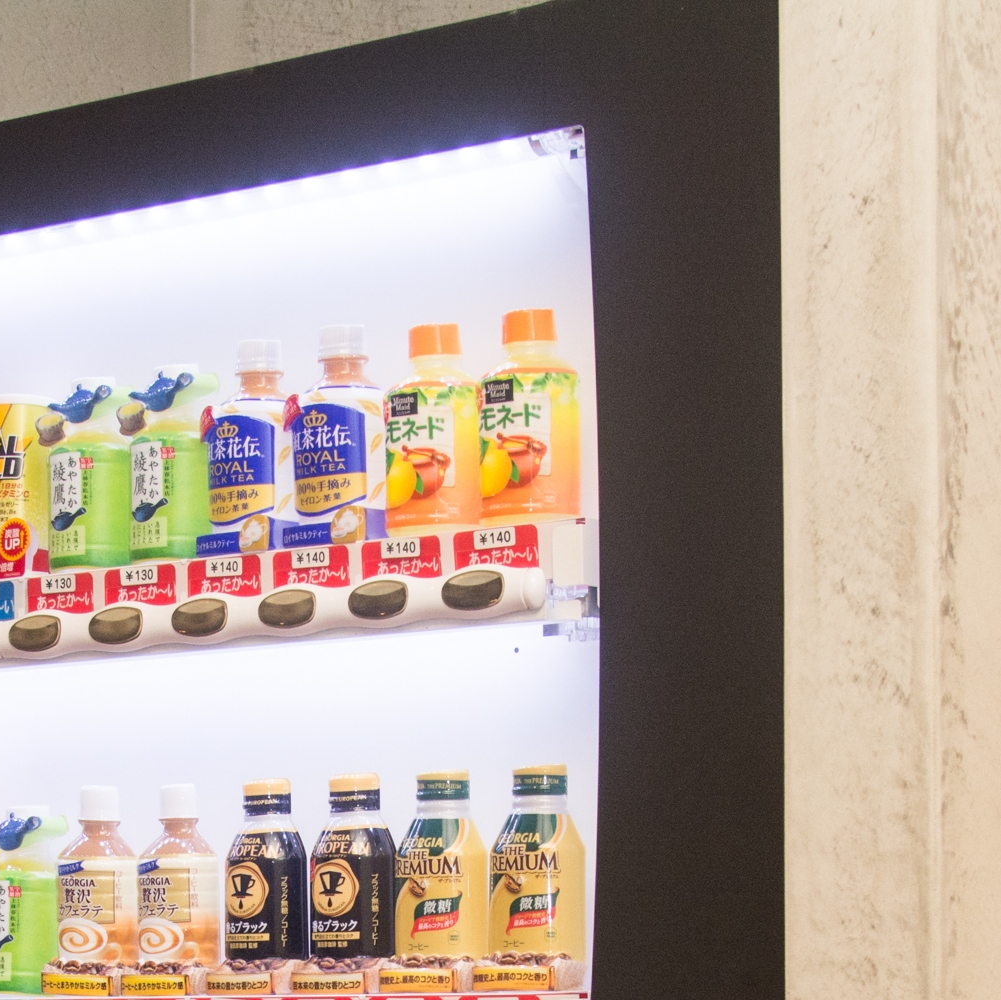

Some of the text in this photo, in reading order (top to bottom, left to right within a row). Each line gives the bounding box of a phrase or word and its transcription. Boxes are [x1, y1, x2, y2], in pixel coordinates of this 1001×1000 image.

[296, 449, 346, 467] ROYAL
[133, 451, 148, 496] 綾鷹
[148, 445, 160, 499] あやたか
[321, 463, 346, 473] TEA
[52, 461, 67, 506] 綾鷹
[66, 455, 79, 509] あやたか
[231, 473, 255, 483] TEA
[4, 537, 20, 550] UP
[479, 531, 511, 545] ¥140
[386, 541, 416, 555] ¥140
[296, 551, 326, 565] ¥140
[211, 561, 239, 573] ¥140
[125, 569, 154, 582] ¥130
[45, 577, 72, 590] ¥130
[407, 850, 428, 861] THE
[503, 846, 525, 857] THE
[397, 856, 463, 877] REMIUM
[492, 851, 561, 872] REMIUM
[61, 875, 98, 888] GEORGIA
[139, 876, 173, 888] GEORGIA
[64, 888, 92, 904] 贅沢
[142, 888, 167, 903] 贅沢
[59, 904, 104, 919] カフェラテ
[139, 904, 179, 919] カフェラテ
[423, 898, 453, 916] 微糖
[408, 942, 430, 951] コーヒー
[503, 940, 526, 949] コーヒー
[42, 980, 107, 991] コーヒーとまろやかなミルク感
[121, 981, 185, 991] コーヒーとまろやかなミルク感
[207, 980, 269, 991] 豆本来の豊かな香りとコク
[293, 979, 361, 991] 豆本来の豊かな香りとコク
